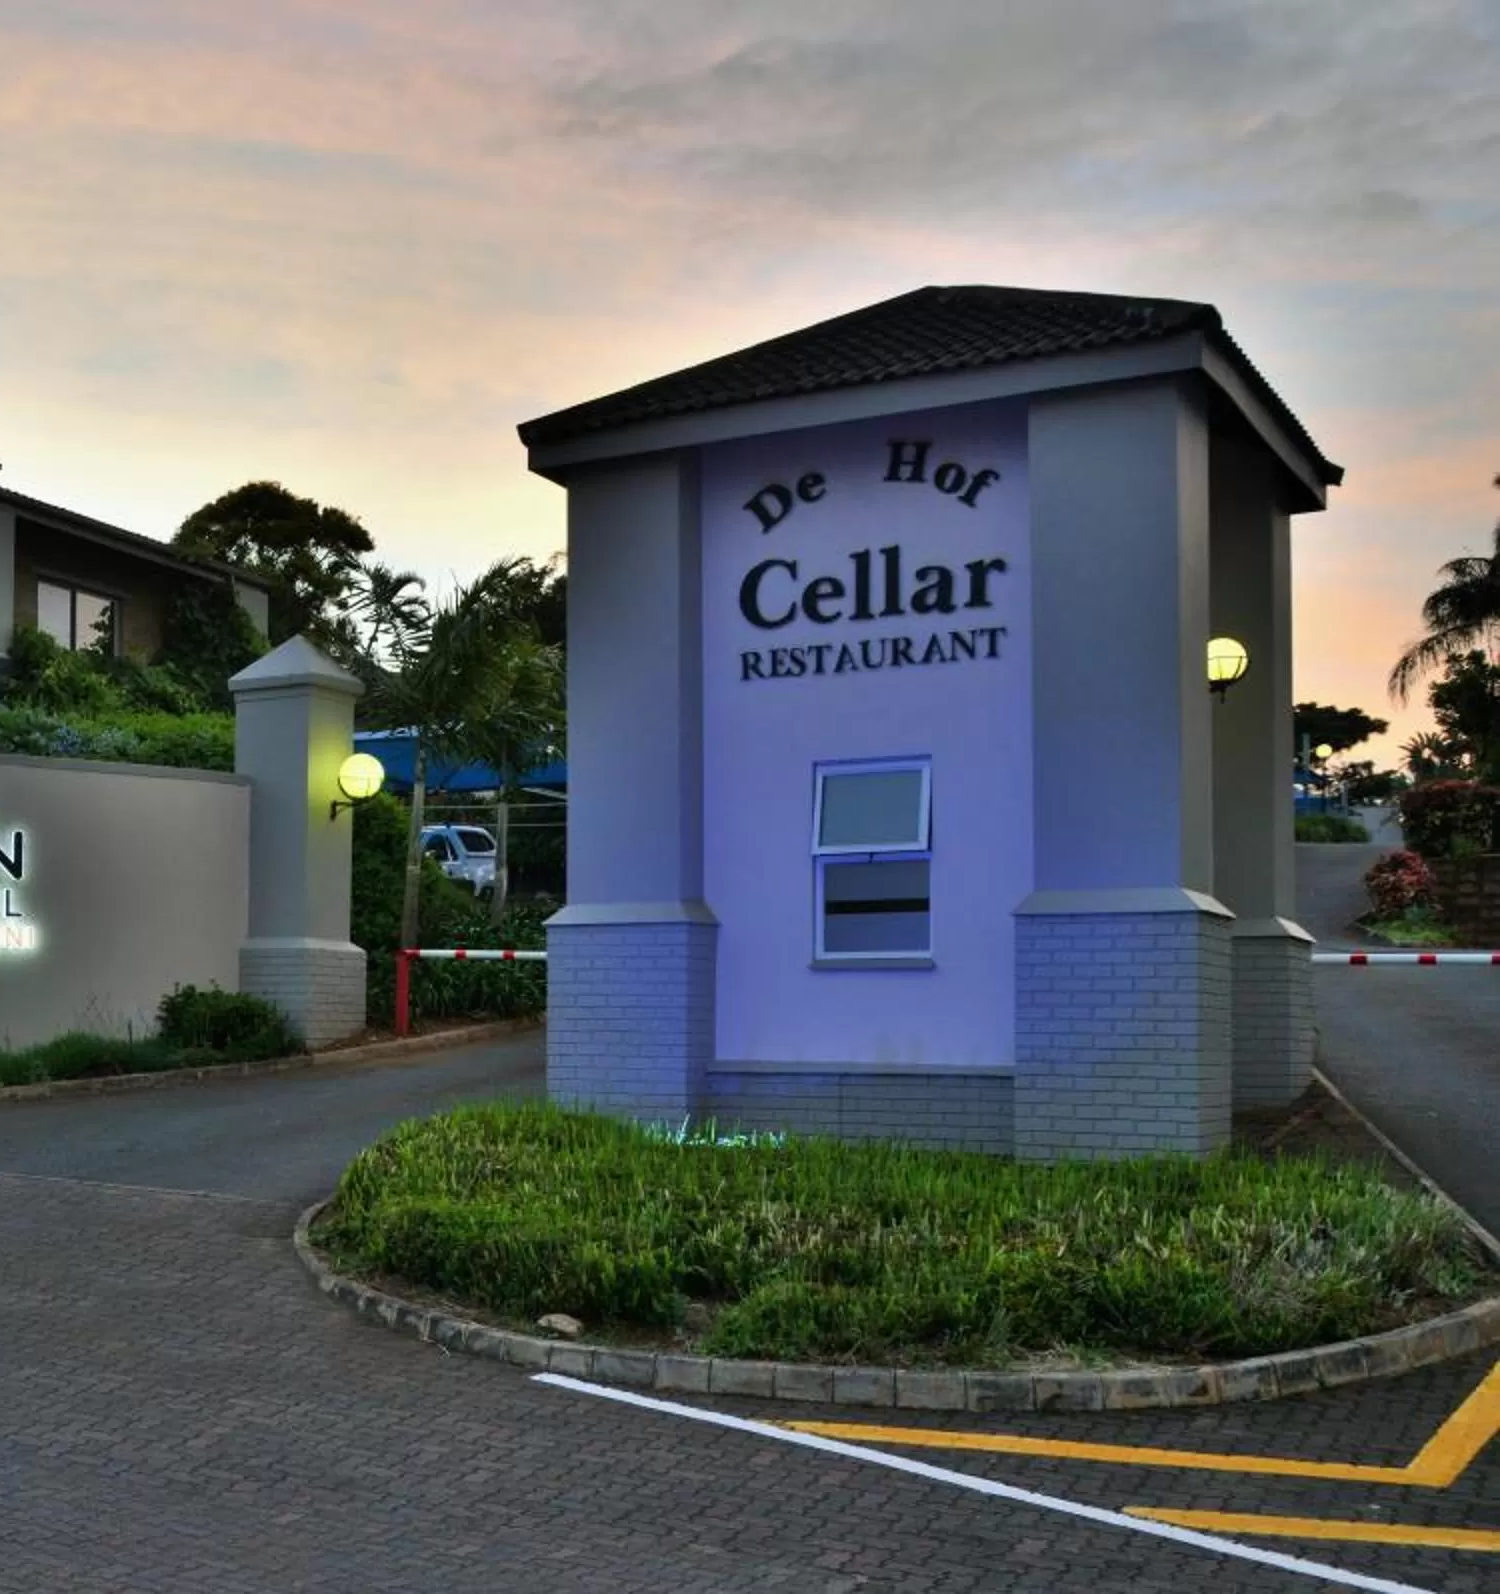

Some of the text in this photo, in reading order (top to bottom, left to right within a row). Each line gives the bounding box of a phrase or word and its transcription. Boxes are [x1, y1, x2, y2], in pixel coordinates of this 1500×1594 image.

[742, 440, 1000, 535] De Hof
[739, 544, 1007, 630] Cellar
[739, 626, 1007, 682] RESTAURANT
